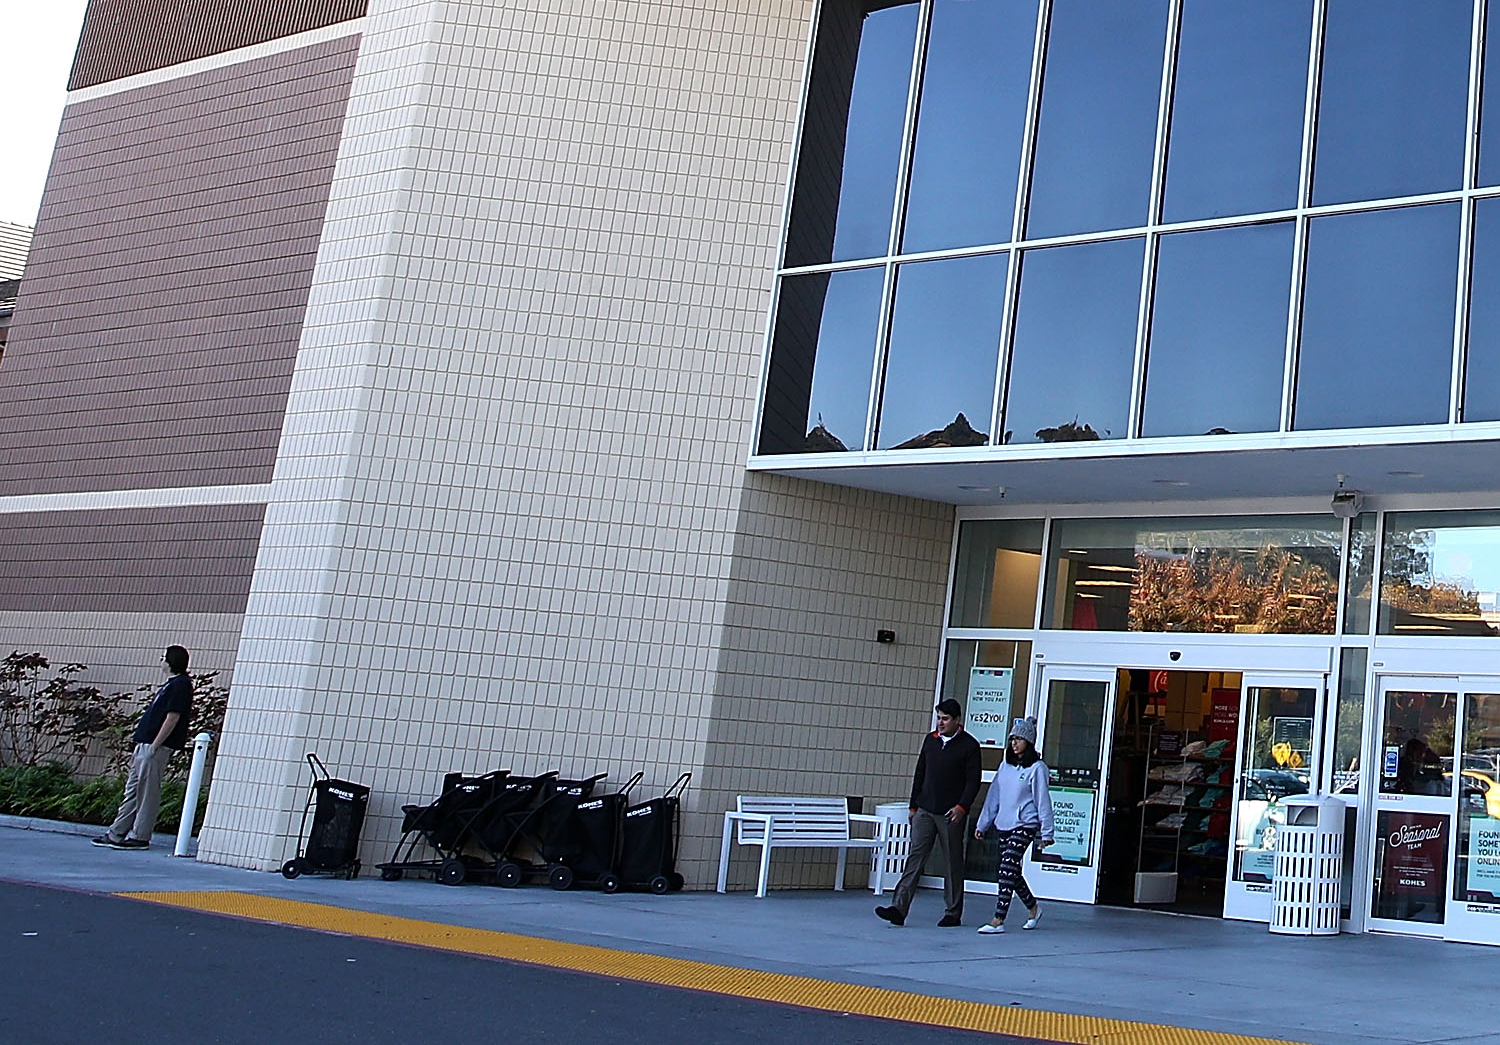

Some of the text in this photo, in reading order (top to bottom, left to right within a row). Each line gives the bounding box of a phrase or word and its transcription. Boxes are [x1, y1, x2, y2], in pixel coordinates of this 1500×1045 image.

[970, 712, 1005, 723] YES2YOU
[1053, 801, 1074, 809] FOUND
[1065, 817, 1080, 826] LOVE
[1389, 821, 1443, 848] Seasonal
[1406, 842, 1422, 850] TEAM
[1477, 848, 1494, 857] YOU
[1399, 878, 1426, 887] KOHL'S
